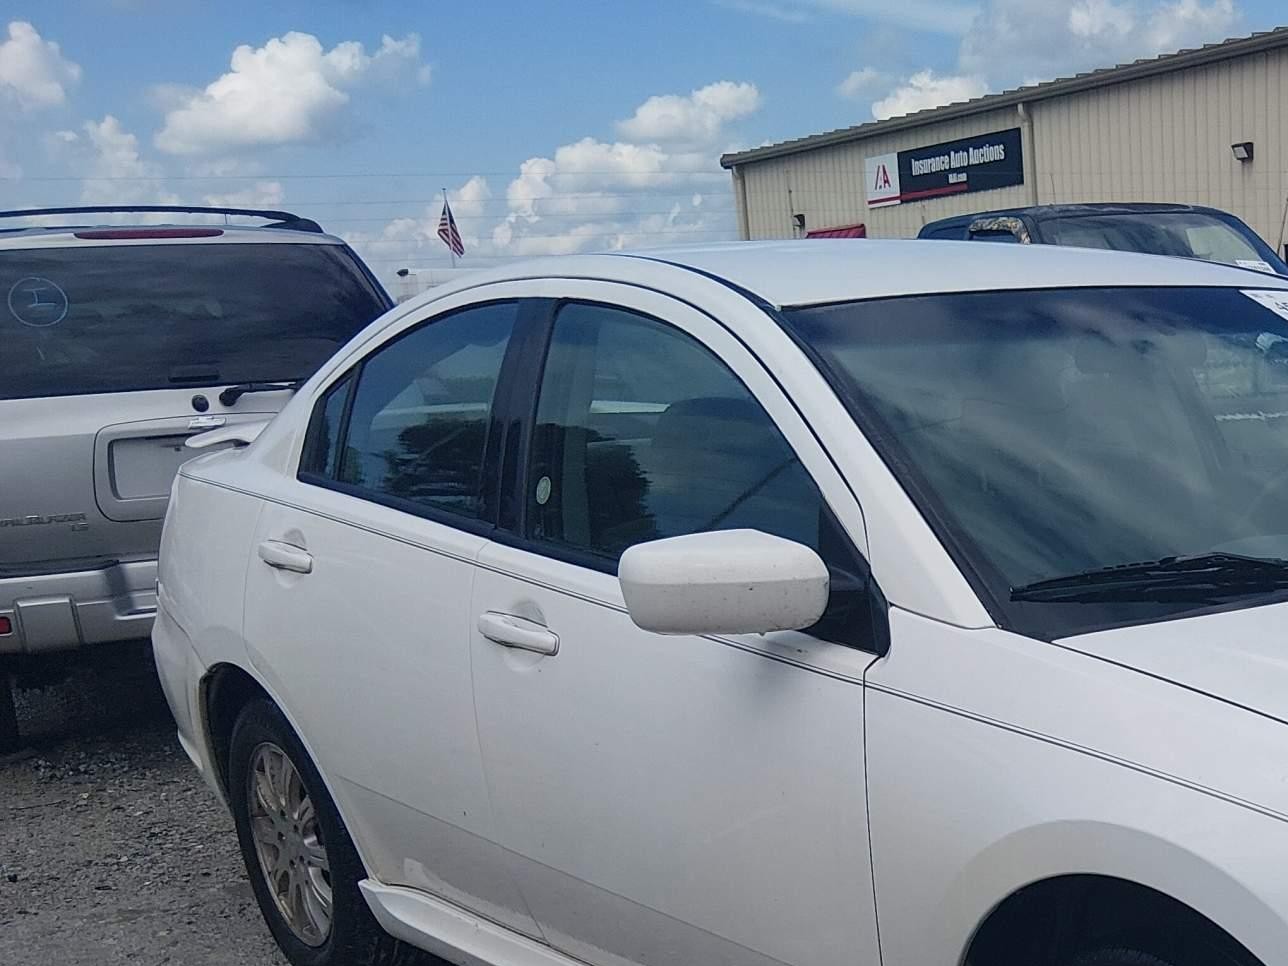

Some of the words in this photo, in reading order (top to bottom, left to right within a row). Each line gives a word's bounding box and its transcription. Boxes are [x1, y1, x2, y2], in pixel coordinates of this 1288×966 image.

[911, 155, 949, 177] Insurance
[950, 150, 968, 169] Auto
[969, 143, 1005, 166] Auctions
